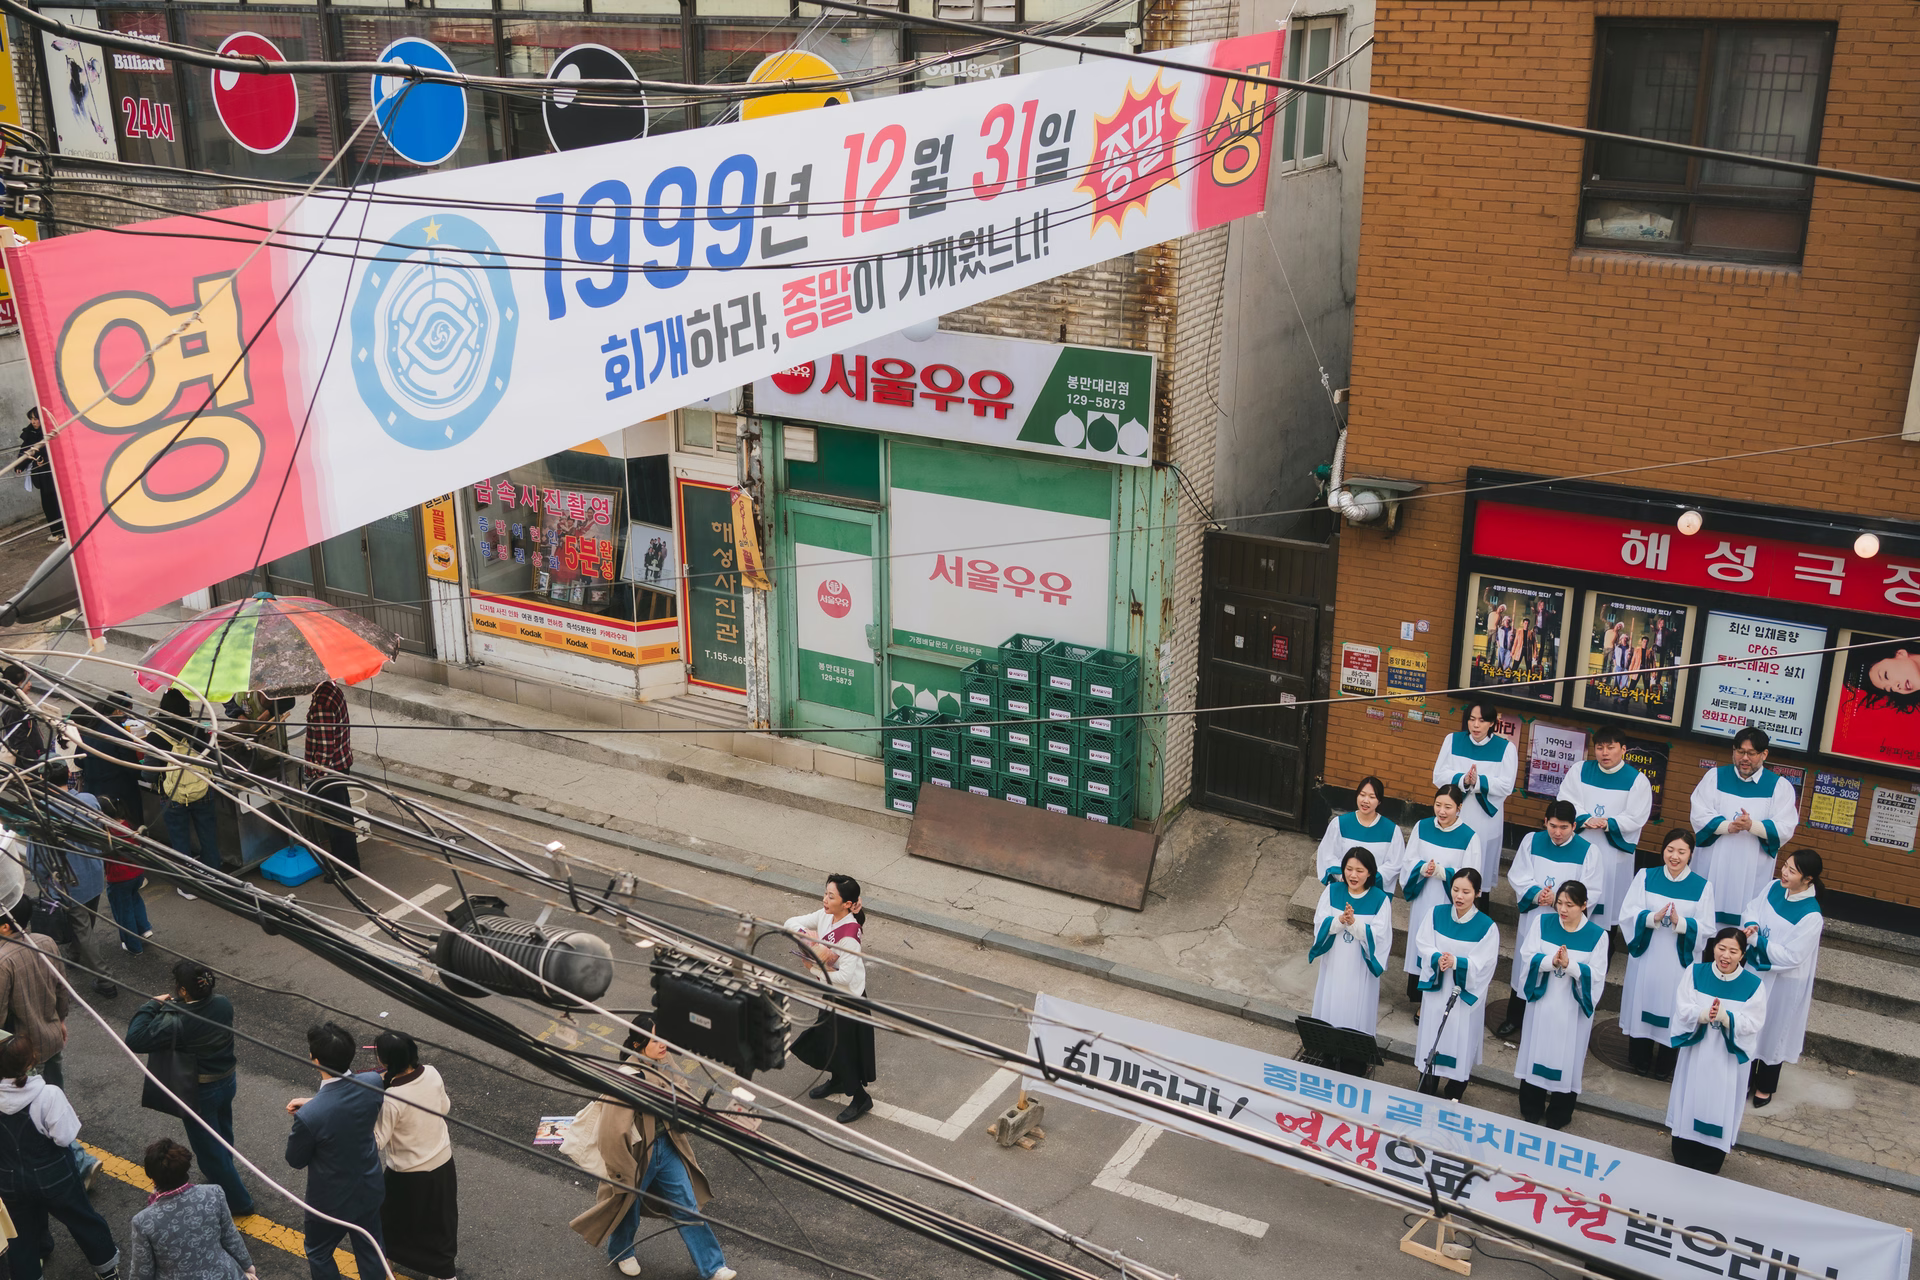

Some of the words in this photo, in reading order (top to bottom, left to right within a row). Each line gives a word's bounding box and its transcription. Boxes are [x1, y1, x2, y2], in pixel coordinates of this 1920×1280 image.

[113, 54, 165, 71] Billiard
[924, 60, 1004, 80] Gallery
[122, 96, 175, 143] 24시
[1206, 61, 1271, 187] 생
[1101, 98, 1165, 202] 종말
[535, 153, 813, 321] 1999년
[842, 124, 954, 238] 12월
[972, 99, 1076, 201] 31일
[601, 291, 780, 401] 회개하라,
[782, 254, 886, 339] 종말이
[897, 207, 1050, 302] 가까웠느니!
[820, 354, 1015, 420] 서울우유
[1066, 374, 1130, 396] 봉만대리점
[56, 269, 266, 534] 영
[1066, 393, 1126, 411] 129-5873
[565, 535, 600, 578] 5분
[600, 540, 614, 580] 완성
[928, 554, 1073, 606] 서울우유
[819, 594, 850, 608] 서울우유
[476, 618, 497, 629] Kodak
[1728, 621, 1751, 636] 최신
[1755, 626, 1800, 643] 입체음향
[520, 628, 542, 639] Kodak
[566, 638, 588, 649] Kodak
[909, 635, 948, 650] 가정배달문의
[955, 644, 982, 657] 단체주문
[1747, 644, 1778, 656] CP65
[612, 648, 635, 659] Kodak
[818, 662, 855, 677] 봉만대리점
[1784, 665, 1805, 680] 설치
[821, 673, 852, 686] 129-5873
[1749, 704, 1776, 717] 사시는
[1545, 736, 1573, 749] 1999년
[1540, 748, 1556, 758] 12월
[1558, 751, 1576, 762] 31일
[1531, 758, 1560, 773] 종말의
[1820, 785, 1859, 800] 853-3032
[1878, 791, 1903, 801] 고시원
[1263, 1062, 1372, 1114] 종말이
[1385, 1094, 1424, 1127] 곧
[1436, 1109, 1621, 1182] 닥치리라!
[1275, 1110, 1476, 1200] 영생으로
[1495, 1173, 1617, 1244] 구원
